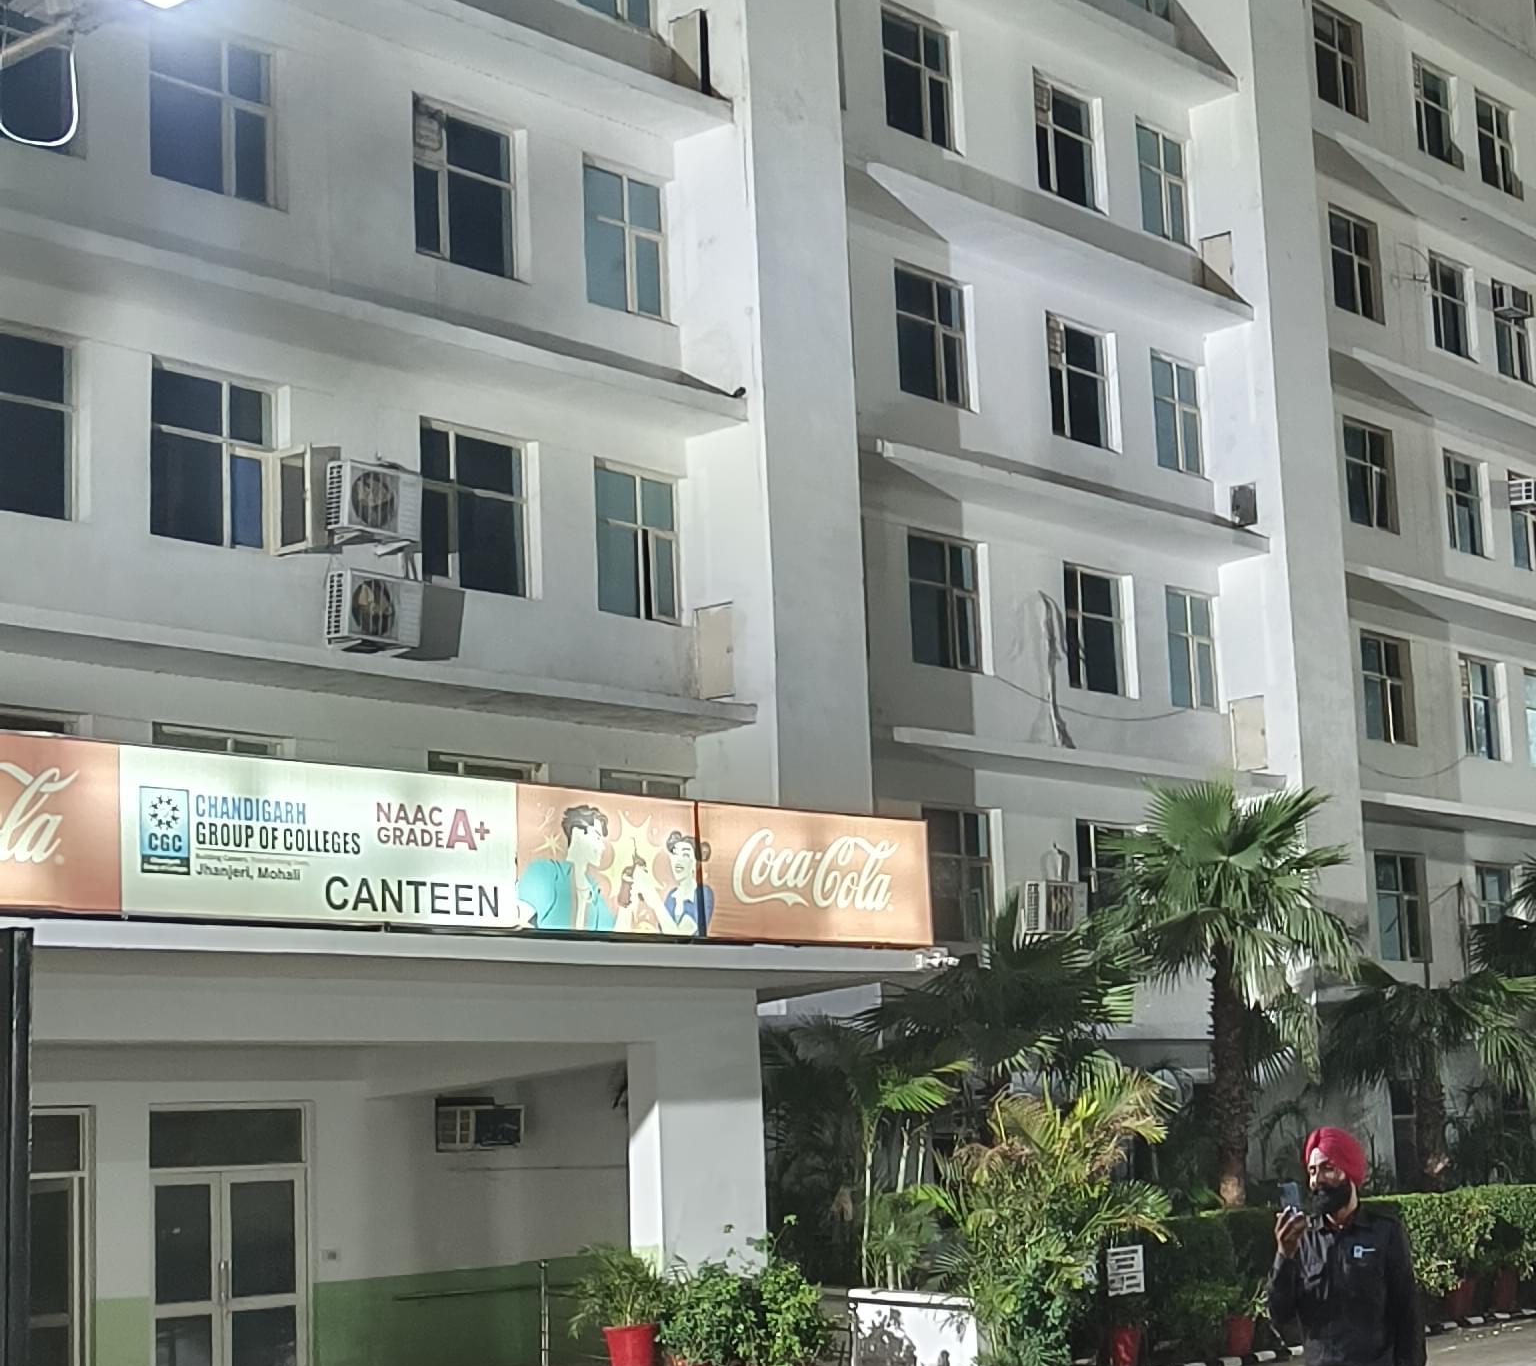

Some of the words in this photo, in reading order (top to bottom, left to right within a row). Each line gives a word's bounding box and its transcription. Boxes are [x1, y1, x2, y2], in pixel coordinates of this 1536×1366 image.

[195, 794, 307, 825] CHANDIGARH
[376, 801, 443, 827] NAAC
[148, 832, 183, 853] CGC
[196, 821, 254, 848] GROUP
[259, 826, 278, 850] OF
[283, 828, 361, 855] COLLEGES
[376, 826, 445, 848] GRADE
[446, 808, 491, 851] A+
[257, 866, 300, 881] Mohali
[733, 827, 899, 911] Coca-Cola
[325, 875, 499, 918] CANTEEN
